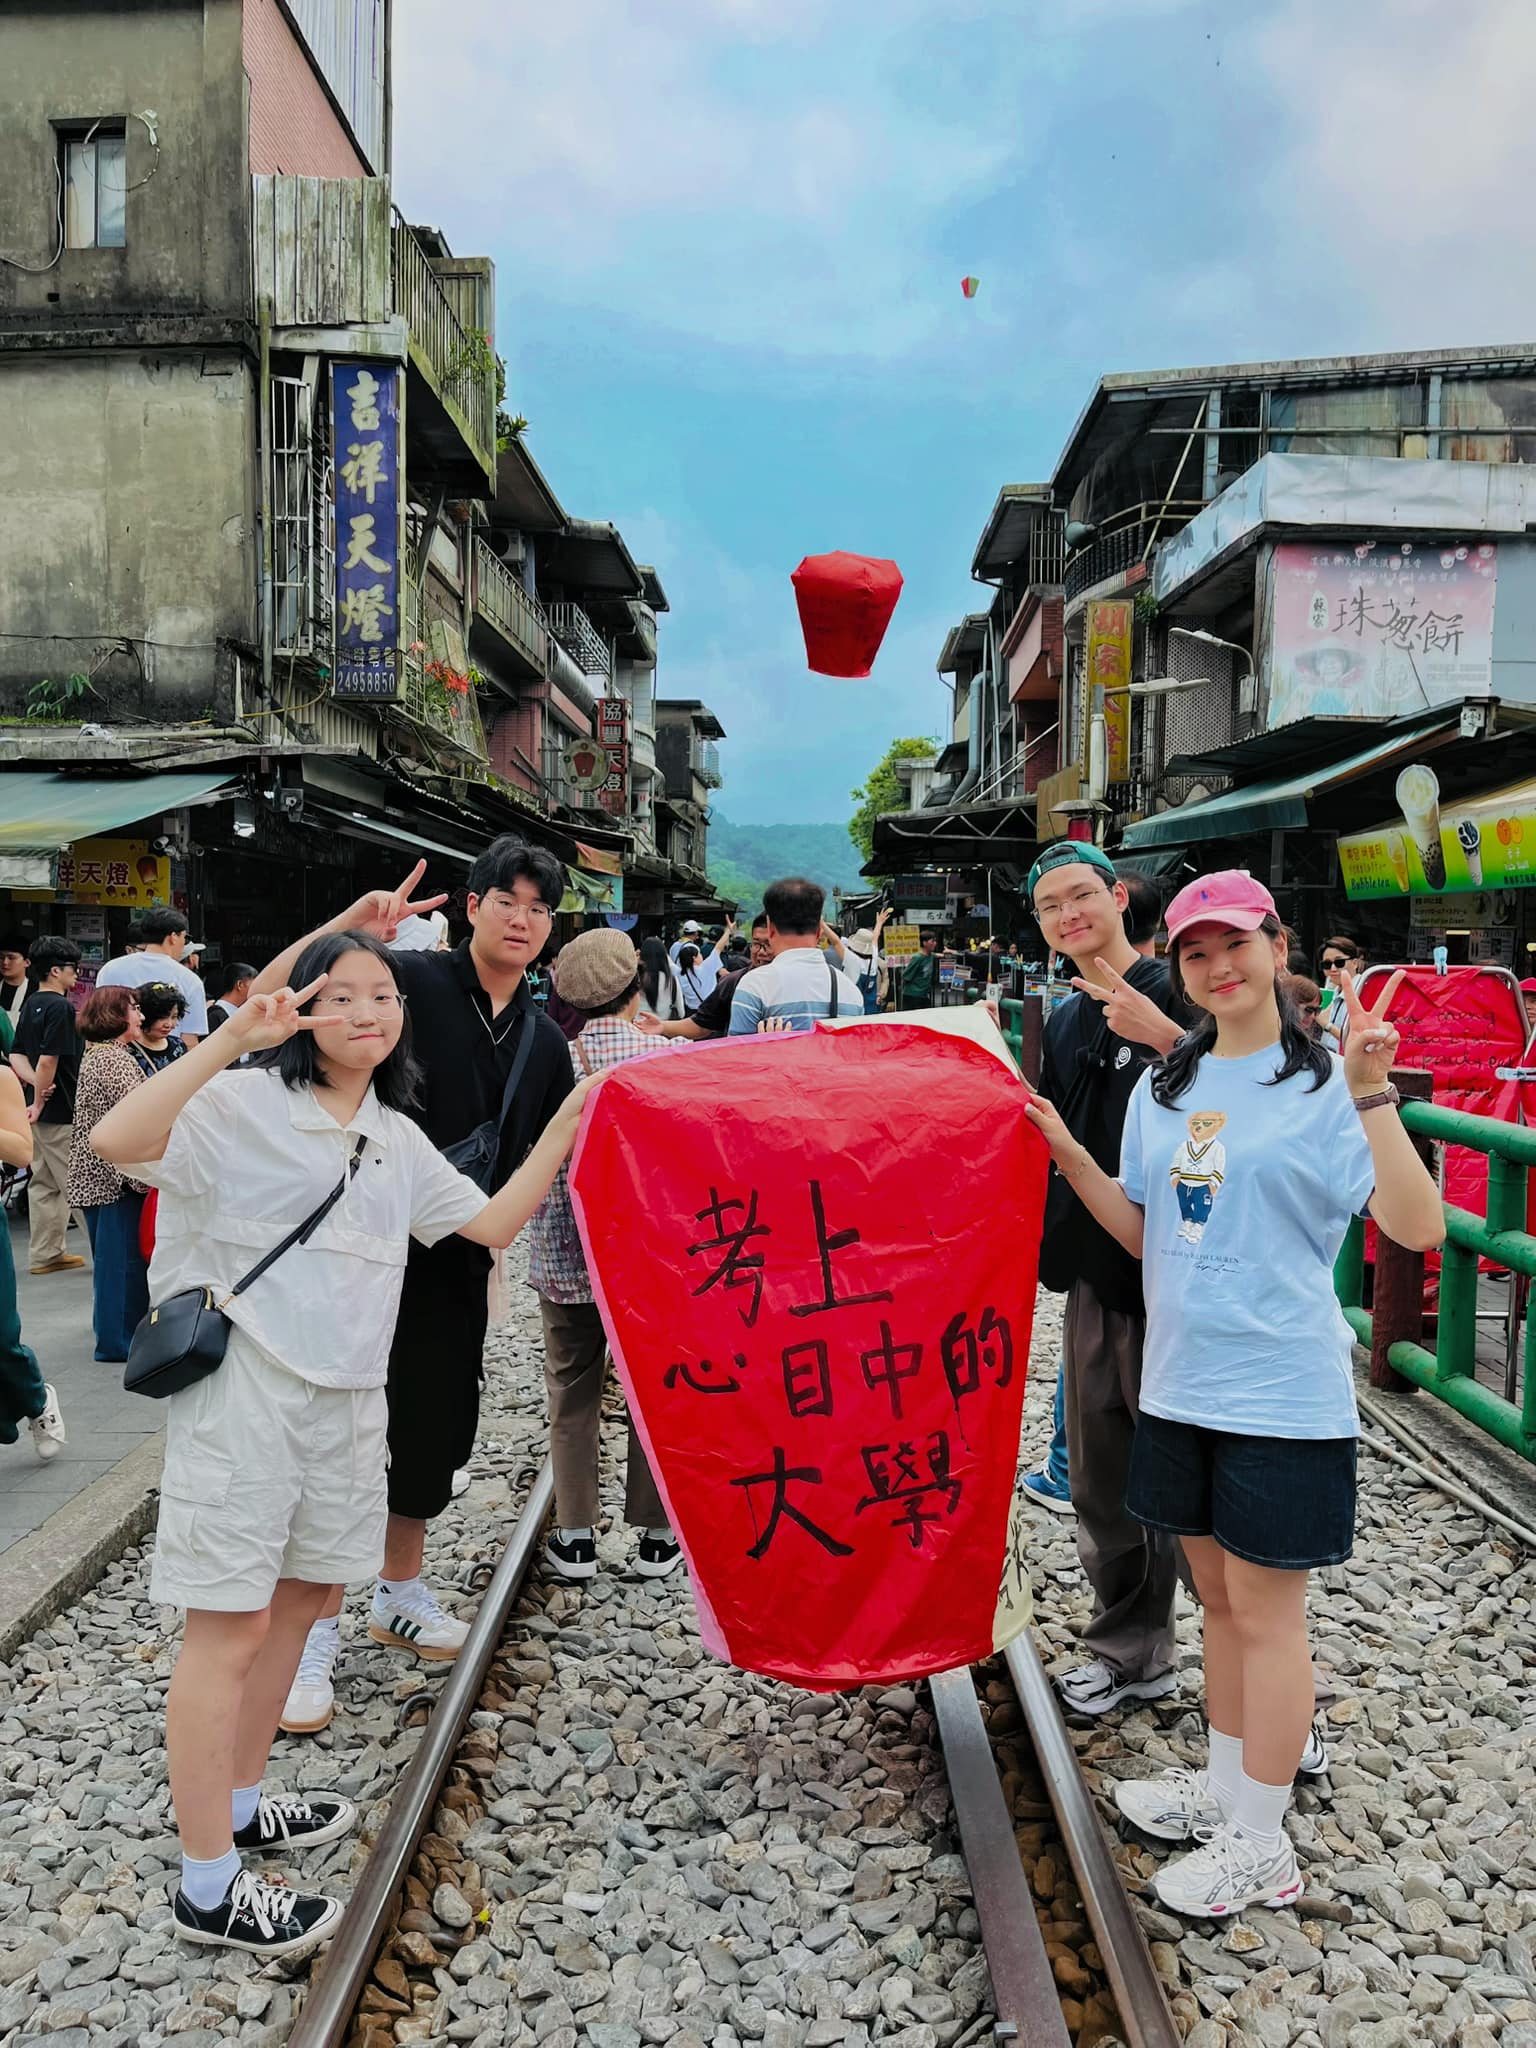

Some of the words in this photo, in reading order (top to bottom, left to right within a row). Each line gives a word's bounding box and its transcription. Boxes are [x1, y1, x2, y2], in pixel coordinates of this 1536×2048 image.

[340, 369, 394, 642] 吉祥天燈
[336, 671, 396, 693] 24958850
[685, 1178, 894, 1328] 考上
[663, 1305, 1014, 1421] 心目中的
[729, 1430, 963, 1561] 大學
